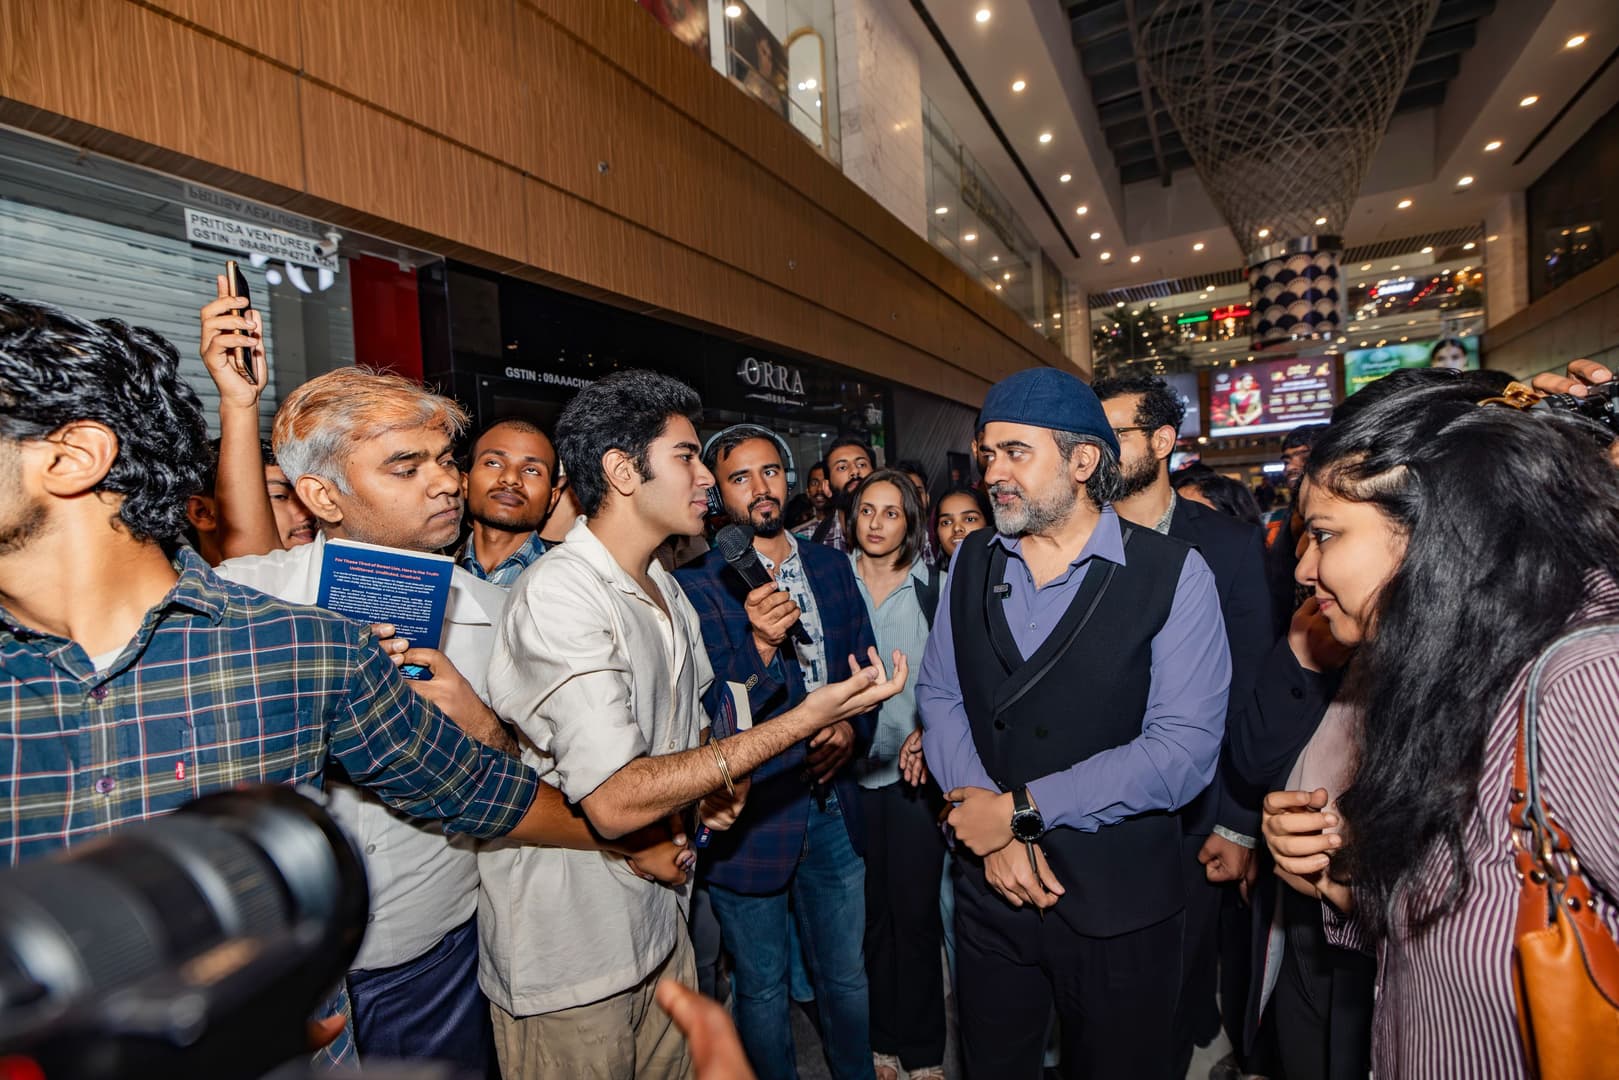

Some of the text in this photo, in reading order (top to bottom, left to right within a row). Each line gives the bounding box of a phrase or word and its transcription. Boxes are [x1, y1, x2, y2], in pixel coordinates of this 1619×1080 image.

[190, 213, 311, 250] PRITISA VENTURES
[192, 228, 229, 244] GSTIN
[505, 366, 536, 381] GSTIN
[743, 357, 805, 394] ORRA
